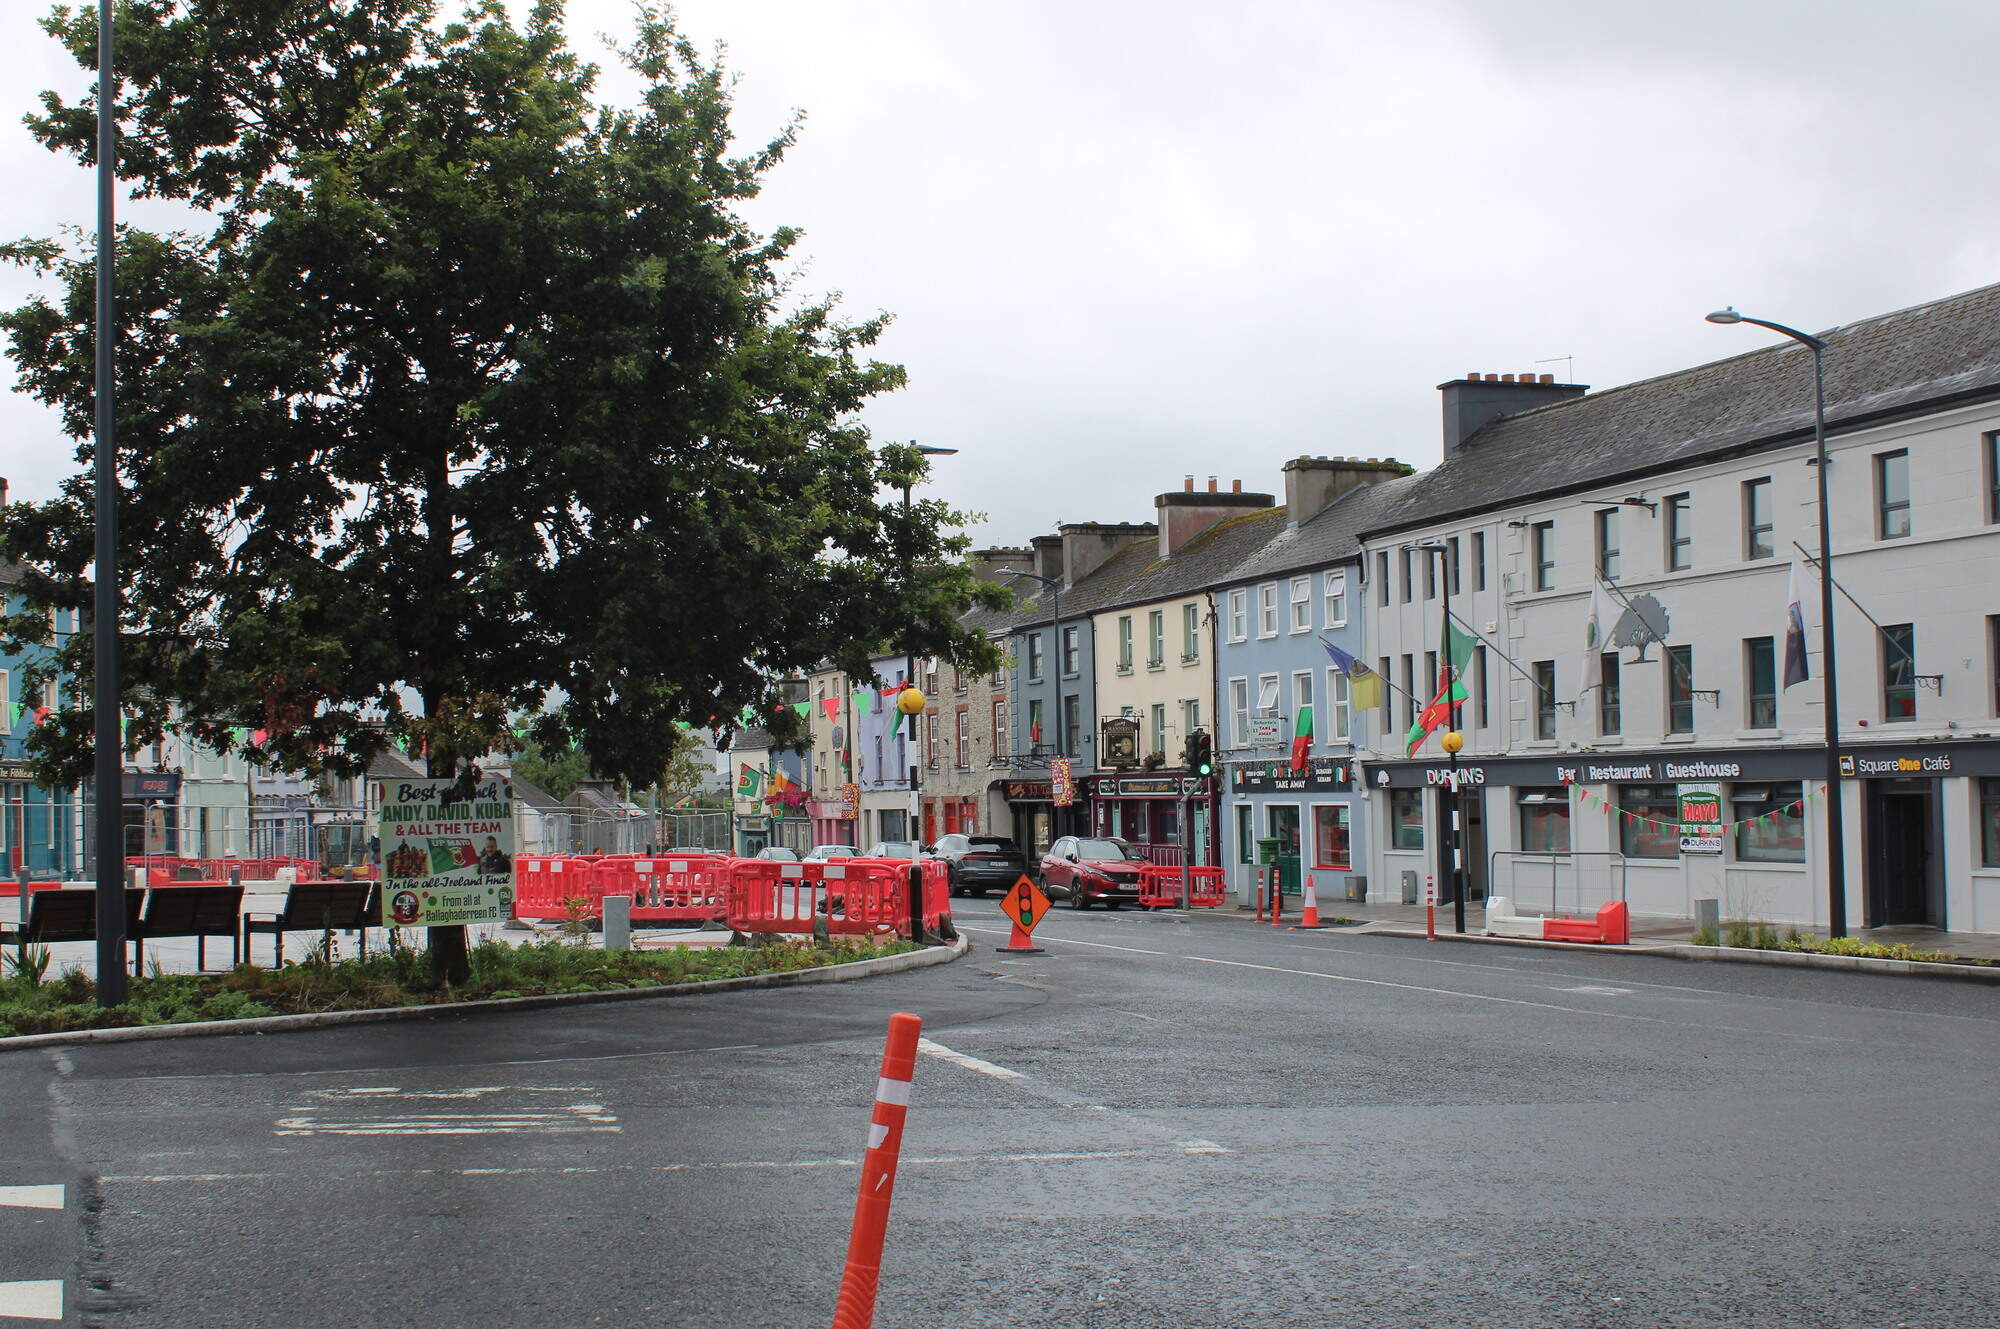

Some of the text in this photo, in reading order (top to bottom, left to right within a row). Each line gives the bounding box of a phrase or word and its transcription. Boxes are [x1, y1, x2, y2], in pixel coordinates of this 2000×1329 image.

[1557, 761, 1740, 781] Bar Restaurant Guesthouse
[1922, 754, 1951, 771] Café
[398, 783, 437, 803] Best
[1275, 780, 1306, 789] TAKE AWAY
[383, 803, 512, 822] ANDY, DAVID, KUBA
[1684, 802, 1718, 822] MAYO
[395, 822, 502, 836] & ALL THE TEAM
[1690, 839, 1721, 847] DURKIN'S
[385, 879, 401, 890] In
[403, 877, 419, 889] the
[485, 874, 510, 886] Final
[442, 894, 481, 907] From all at
[426, 908, 488, 923] Ballaghaderreen
[488, 906, 497, 918] FC
